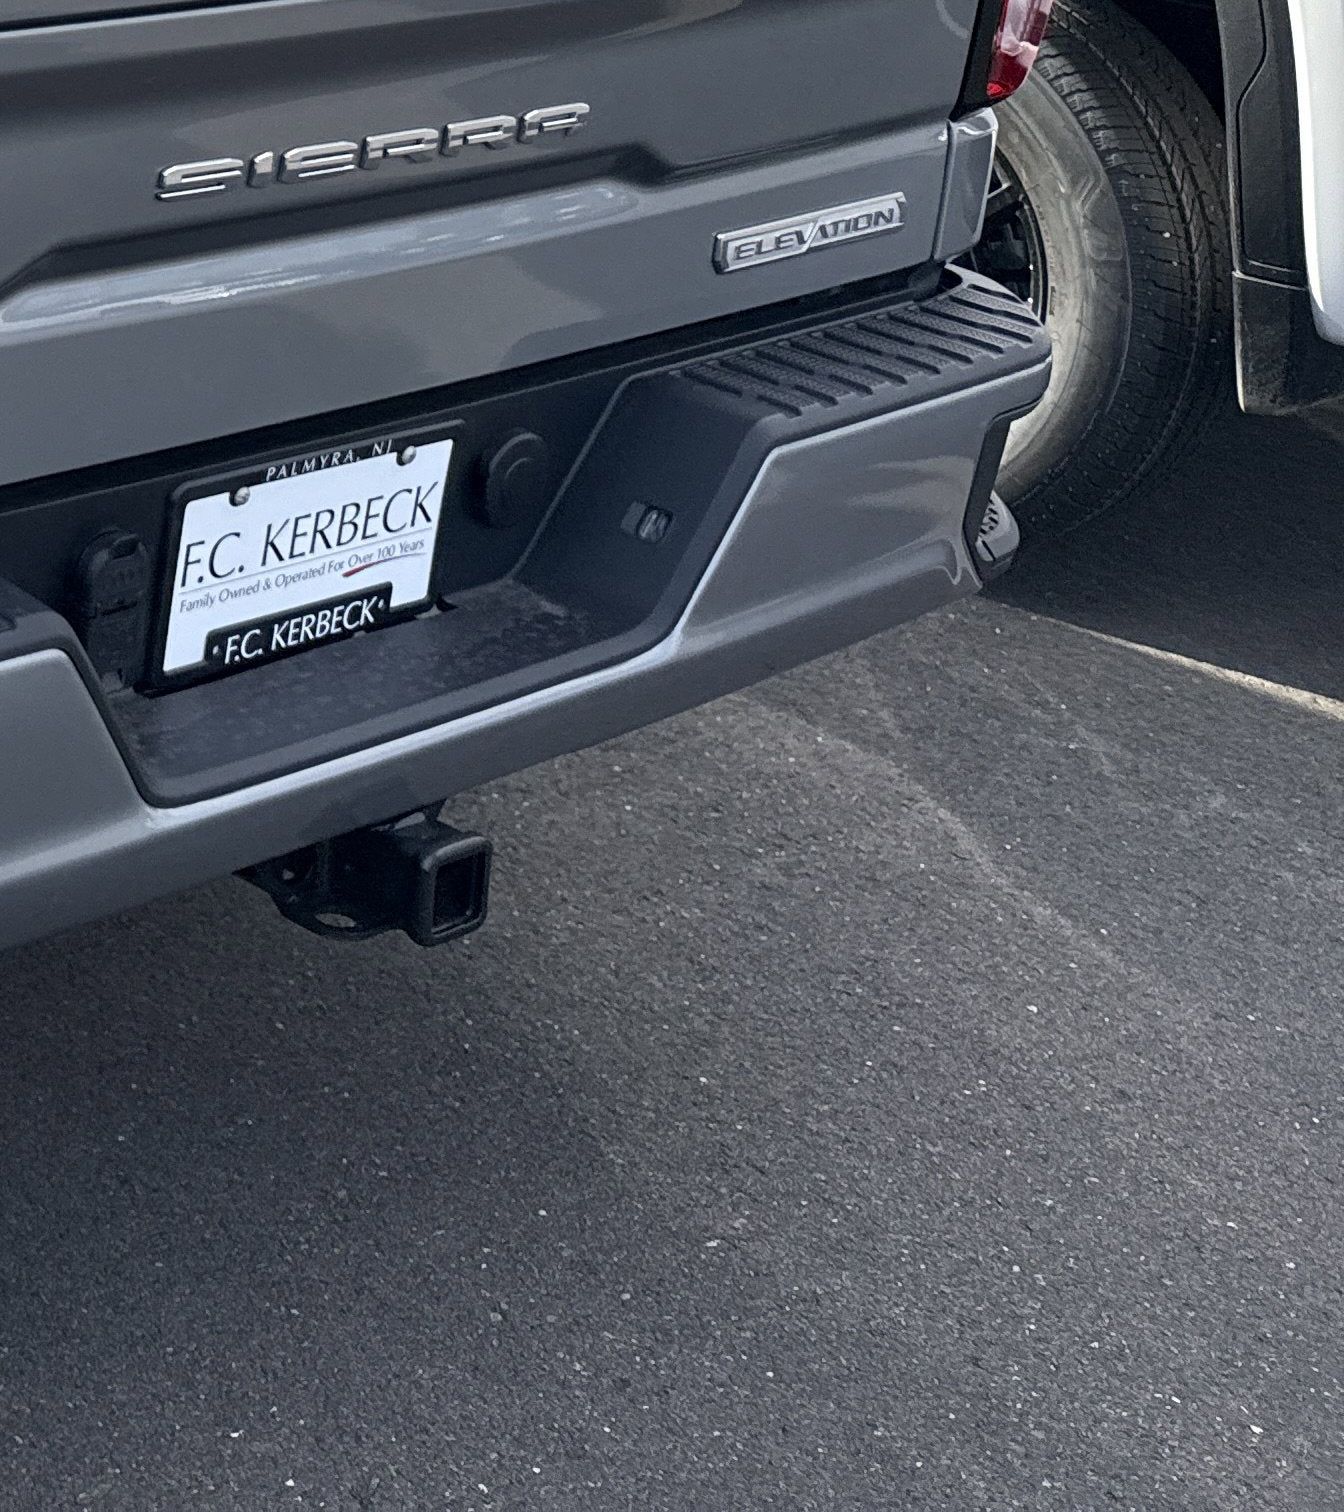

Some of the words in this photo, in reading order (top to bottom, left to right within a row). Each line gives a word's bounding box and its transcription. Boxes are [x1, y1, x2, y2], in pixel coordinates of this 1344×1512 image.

[156, 101, 590, 201] SIERRA
[734, 208, 894, 260] ELEVATION
[265, 448, 361, 481] PALMYRA,
[180, 532, 245, 588] F.C.
[261, 481, 439, 567] KERBECK
[180, 589, 215, 613] Family
[218, 578, 260, 602] Owned
[263, 576, 272, 590] &
[275, 564, 325, 590] Operated
[327, 559, 345, 575] For
[348, 552, 374, 569] Over
[377, 544, 396, 560] 100
[399, 536, 425, 555] Years
[224, 629, 262, 665] F.C.
[271, 594, 379, 651] KERBECK
